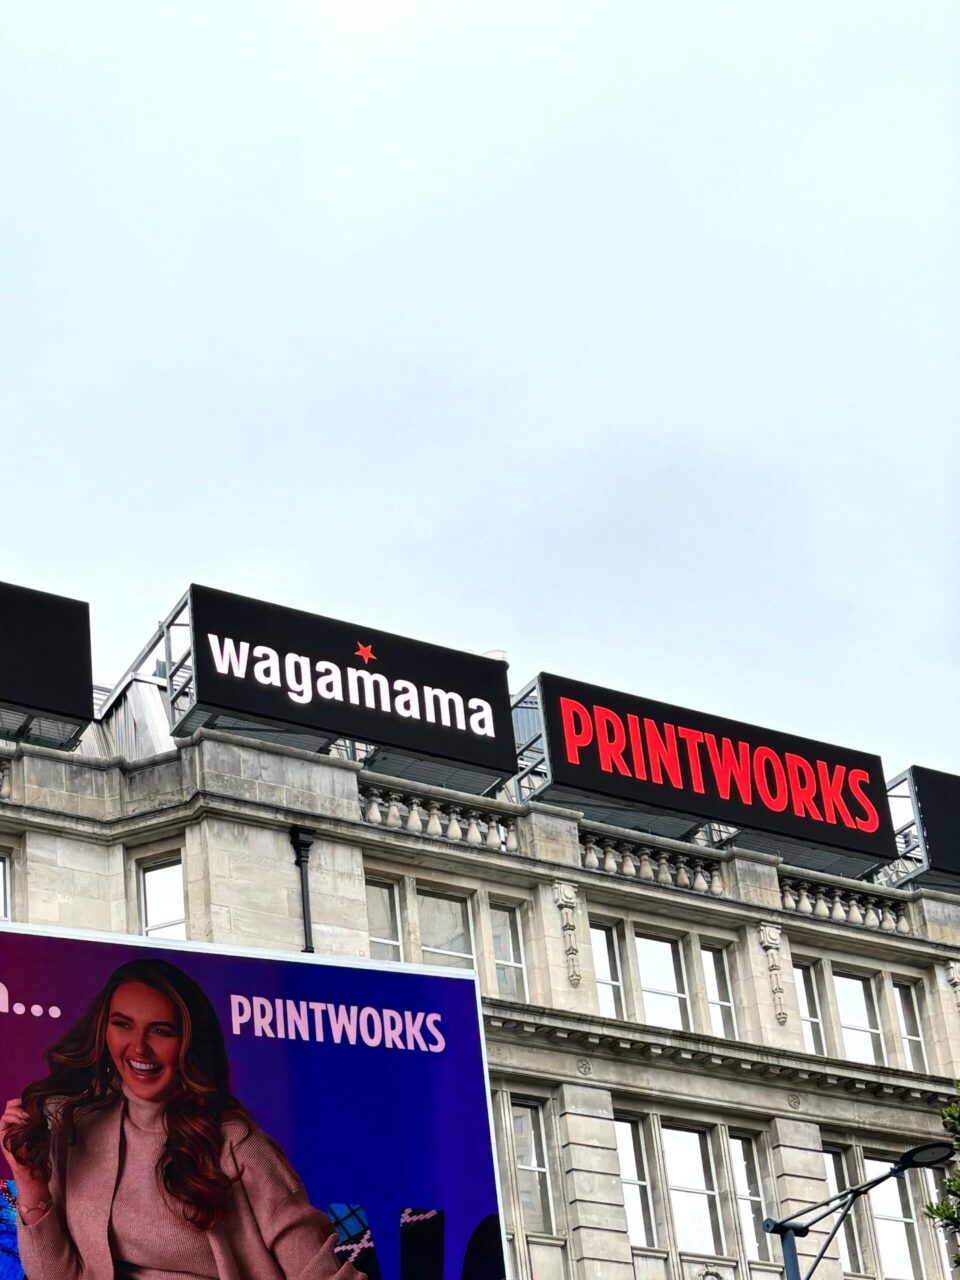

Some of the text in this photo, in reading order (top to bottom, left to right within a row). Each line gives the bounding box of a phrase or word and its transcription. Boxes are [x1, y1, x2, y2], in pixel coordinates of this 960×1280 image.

[207, 633, 496, 738] wagamama
[559, 696, 880, 834] PRINTWORKS
[230, 993, 447, 1053] PRINTWORKS
